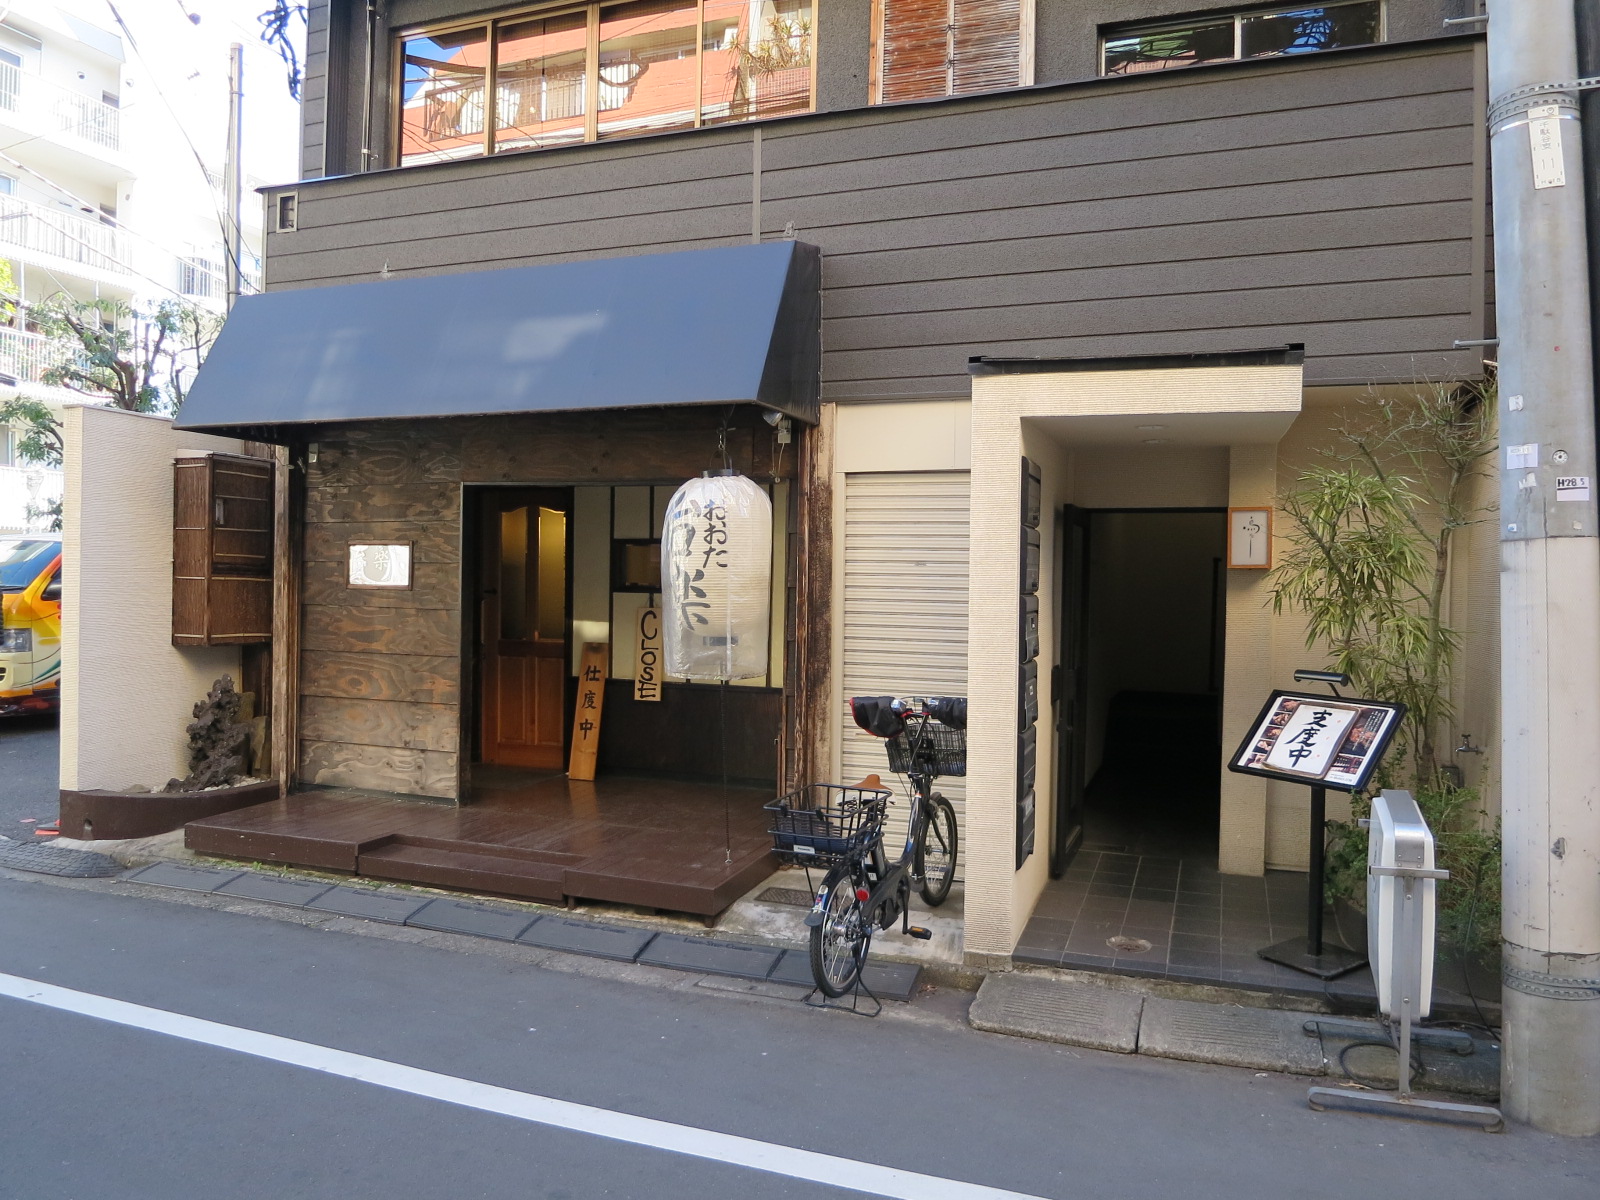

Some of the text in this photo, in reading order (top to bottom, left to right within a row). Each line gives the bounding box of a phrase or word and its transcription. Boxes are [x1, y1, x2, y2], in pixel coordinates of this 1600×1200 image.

[703, 499, 728, 568] おおた
[638, 610, 658, 699] CLOSE
[578, 665, 601, 740] 仕度中
[1284, 709, 1332, 767] 支度中
